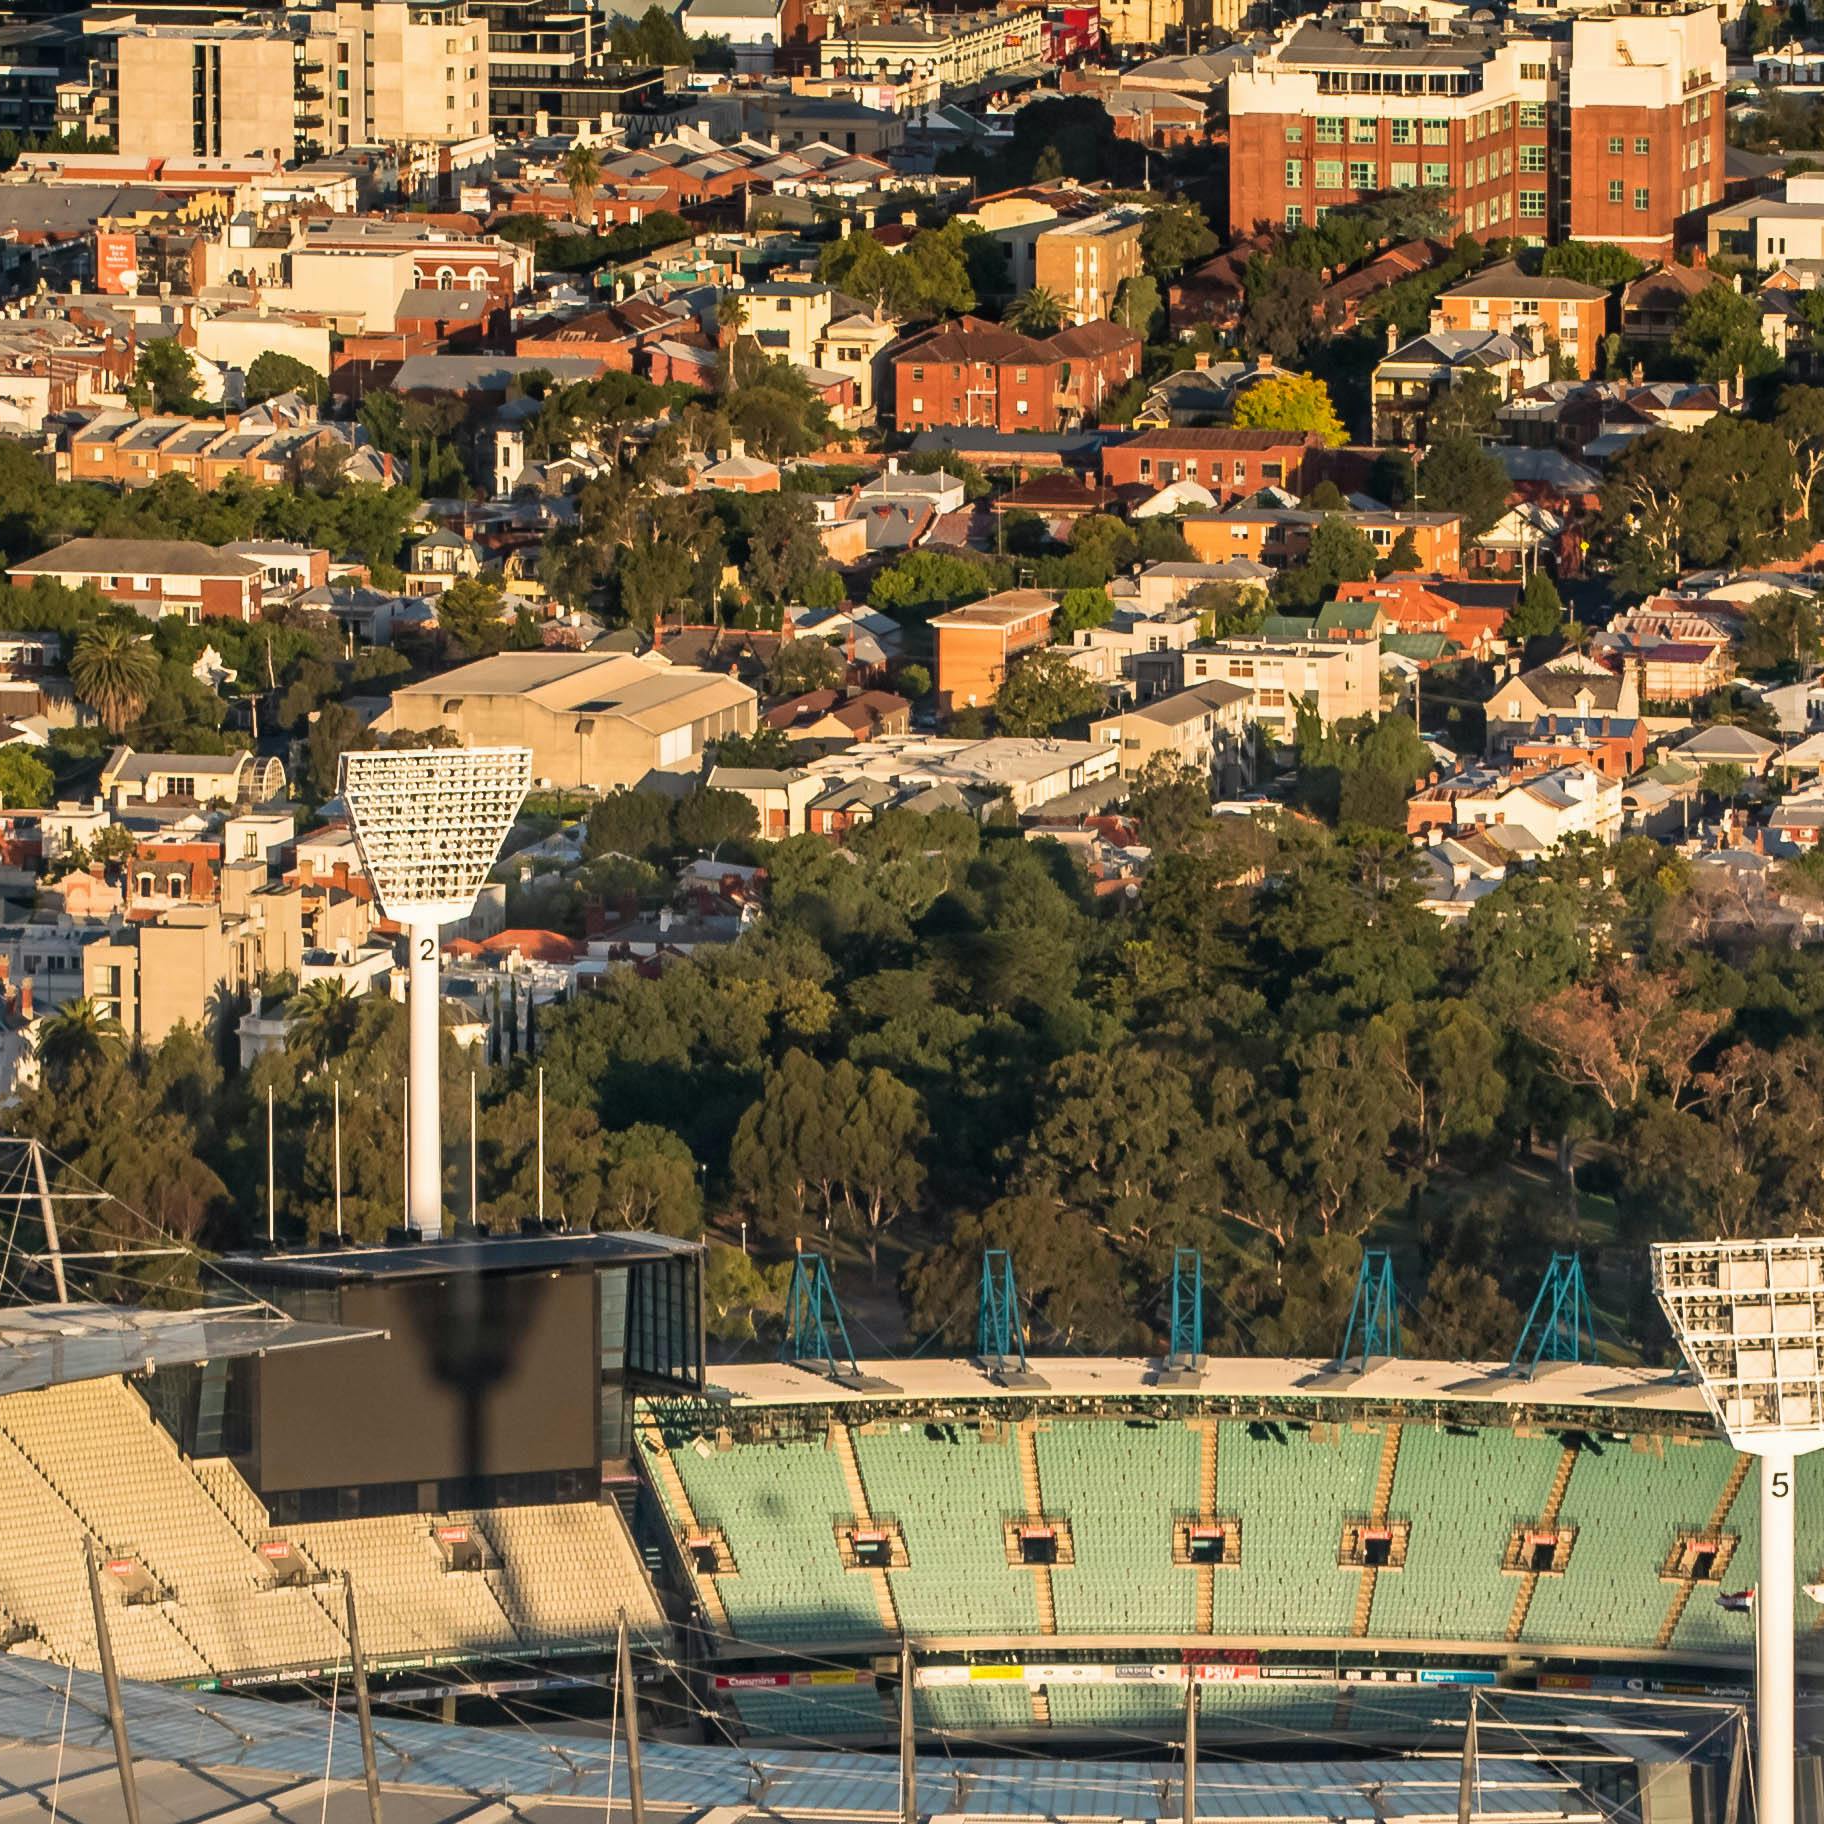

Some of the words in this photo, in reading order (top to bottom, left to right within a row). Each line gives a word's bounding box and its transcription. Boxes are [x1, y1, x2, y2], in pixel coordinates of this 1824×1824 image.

[420, 938, 435, 961] 2
[1771, 1472, 1788, 1498] 5
[232, 1674, 277, 1686] MATADOR
[1205, 1666, 1235, 1680] PSW
[728, 1675, 776, 1687] Cummins
